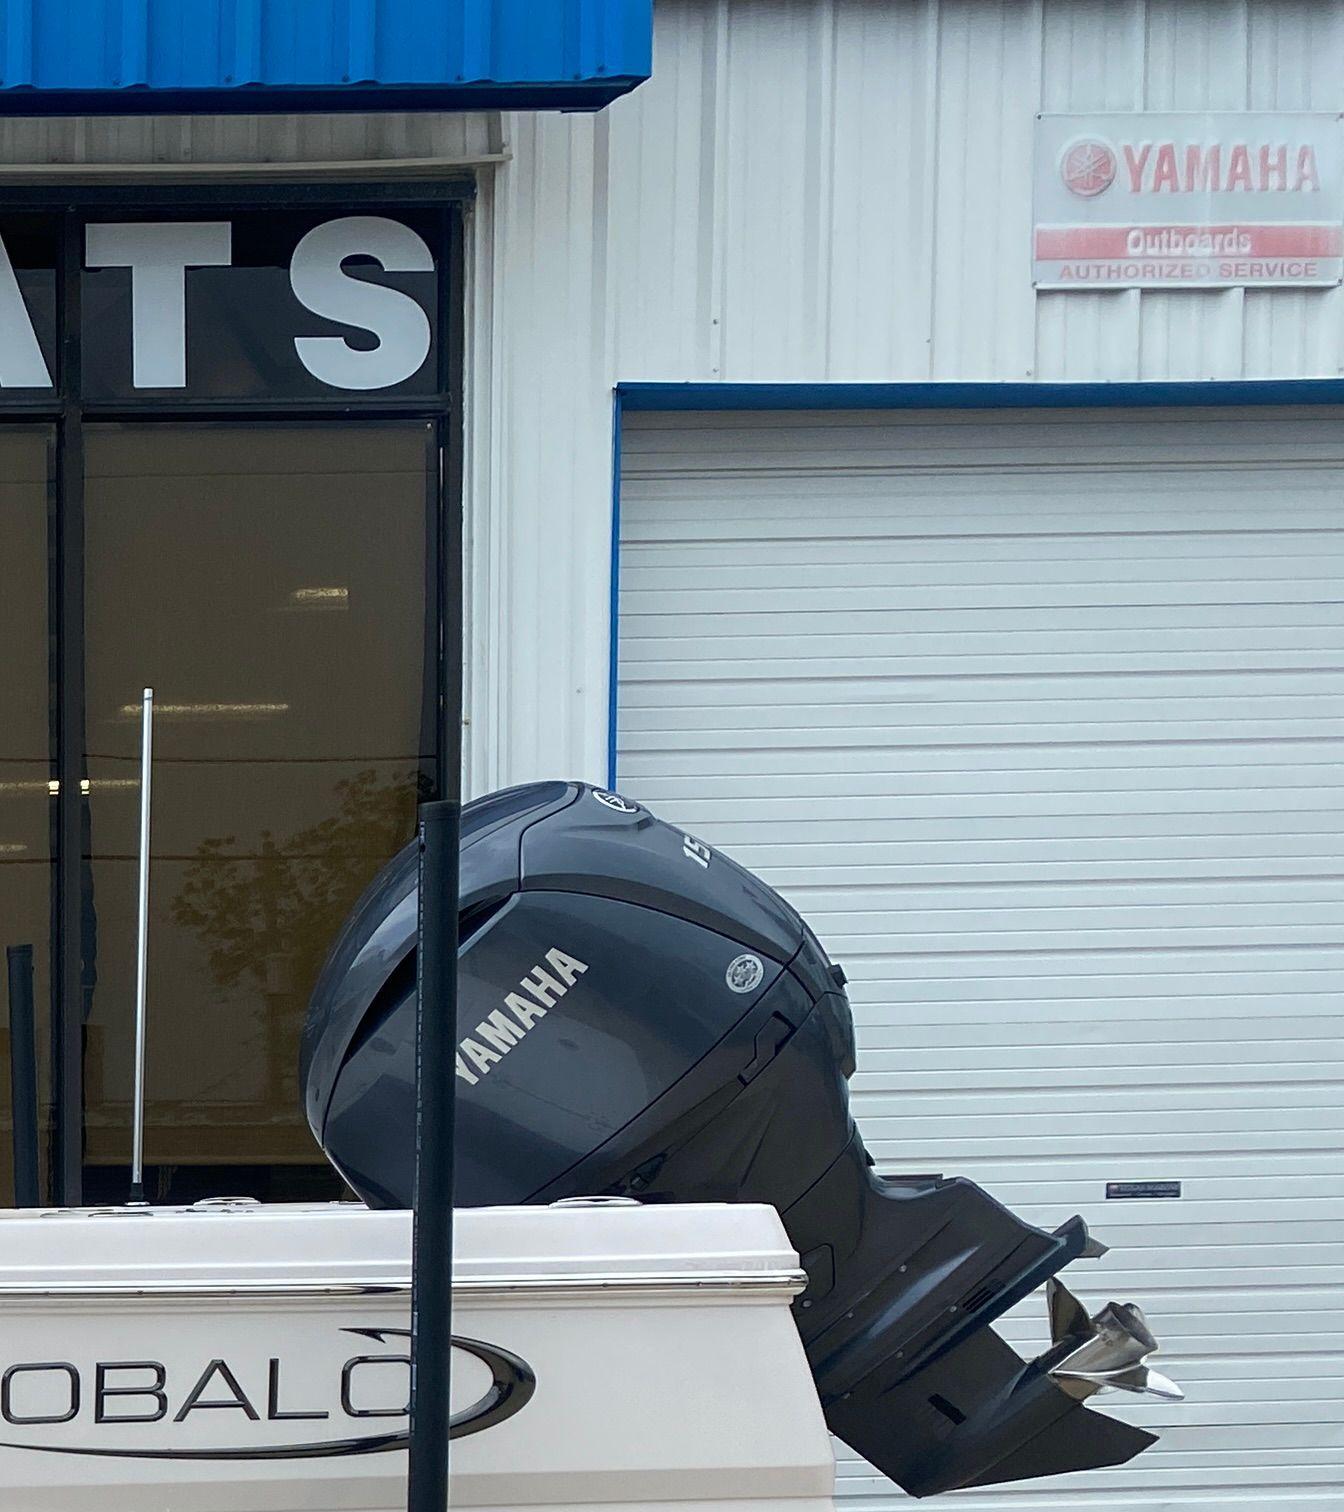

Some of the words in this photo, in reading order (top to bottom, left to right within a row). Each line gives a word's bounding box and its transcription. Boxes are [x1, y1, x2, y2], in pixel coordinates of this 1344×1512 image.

[1122, 143, 1321, 193] YAMAHA
[1126, 227, 1253, 257] Outboards
[1059, 263, 1211, 280] AUTHORIZED
[1218, 262, 1318, 279] SERVICE
[455, 947, 590, 1086] YAMAHA
